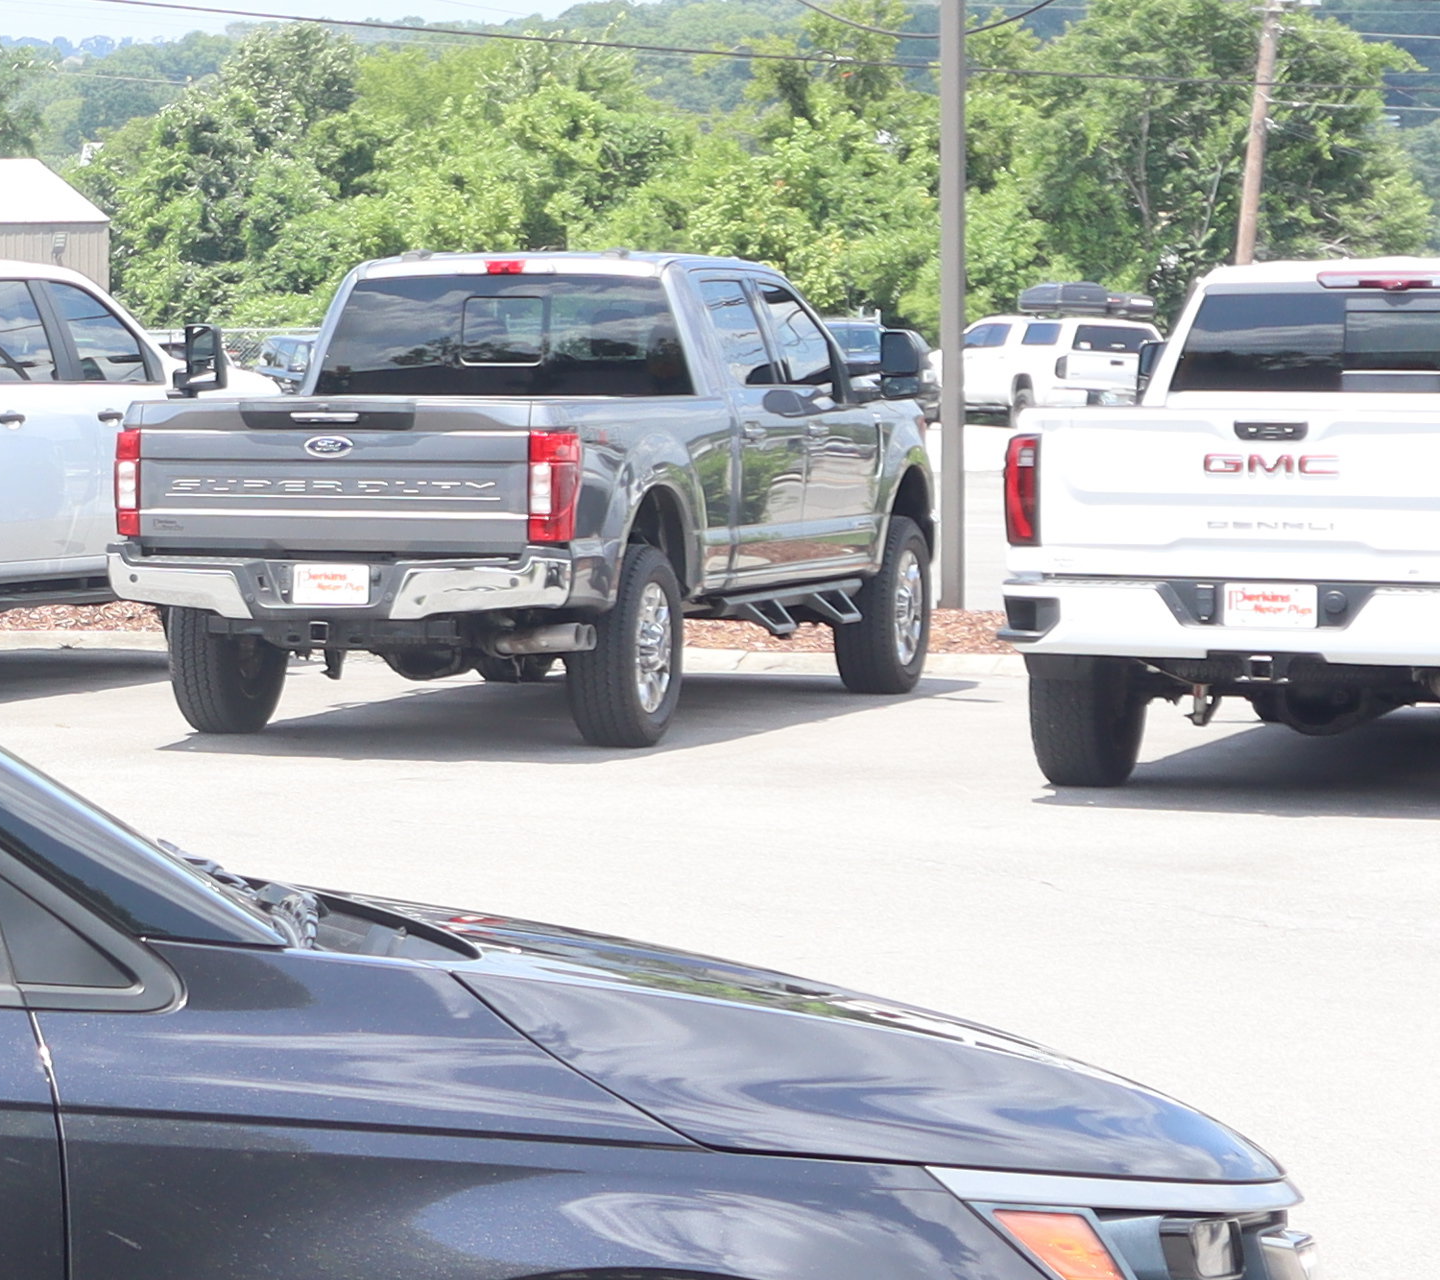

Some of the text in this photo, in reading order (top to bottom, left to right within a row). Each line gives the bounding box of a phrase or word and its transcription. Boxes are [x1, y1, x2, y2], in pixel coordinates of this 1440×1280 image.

[1203, 453, 1340, 479] GMC
[171, 476, 497, 495] SUPER DUTY
[1206, 520, 1335, 531] DENALI
